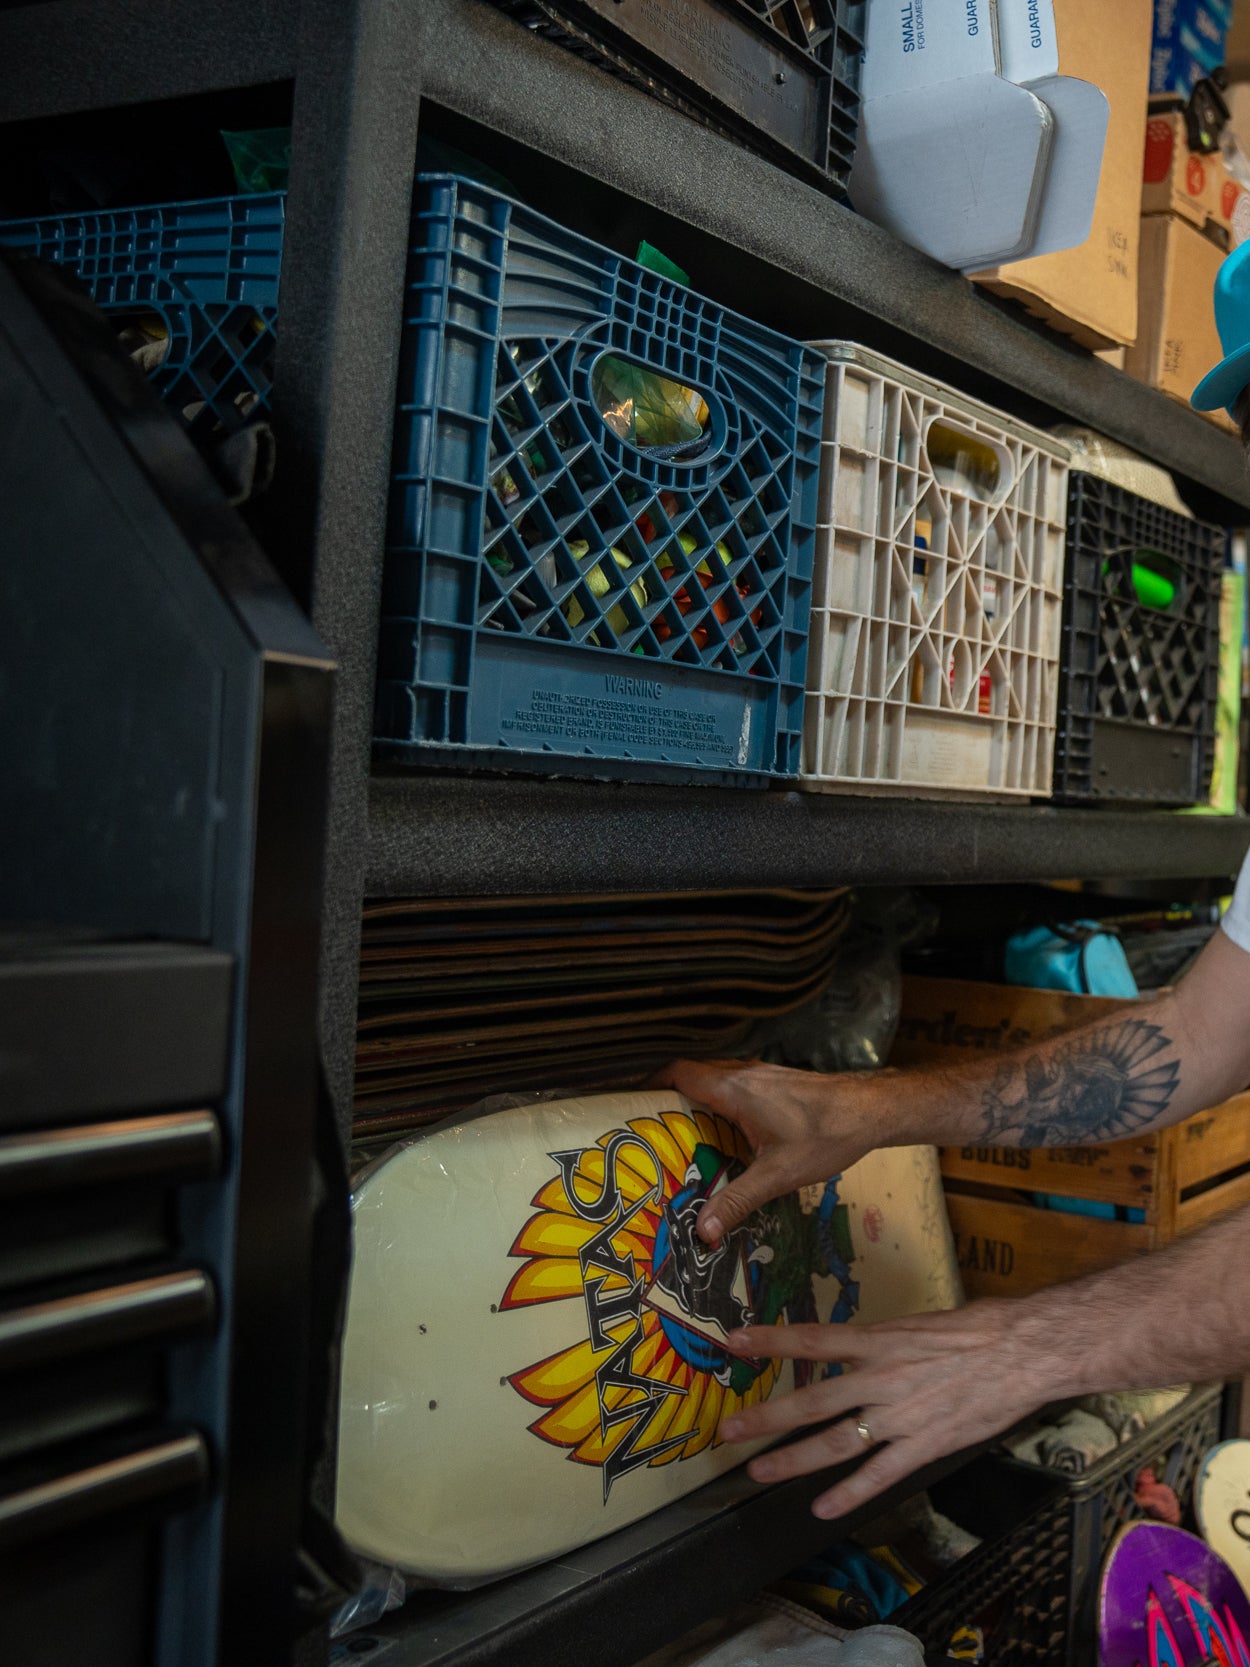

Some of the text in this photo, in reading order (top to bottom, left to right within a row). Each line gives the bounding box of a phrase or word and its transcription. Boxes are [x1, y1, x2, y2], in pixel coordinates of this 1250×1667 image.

[901, 2, 915, 53] SMALL
[916, 33, 926, 50] FOR
[604, 674, 663, 699] WARNING
[515, 709, 566, 724] REGISTERED
[604, 721, 648, 734] PUNISHABLE
[591, 698, 636, 712] POSSESSION
[648, 706, 661, 716] USE
[673, 709, 688, 720] THIS
[688, 712, 705, 721] CASE
[600, 711, 647, 723] DESTRUCTION
[658, 717, 673, 727] THIS
[674, 720, 692, 730] CASE
[501, 720, 564, 735] IMPRISONMENT
[578, 728, 600, 739] BOTH
[627, 734, 647, 744] CODE
[546, 1130, 701, 1507] NATAS
